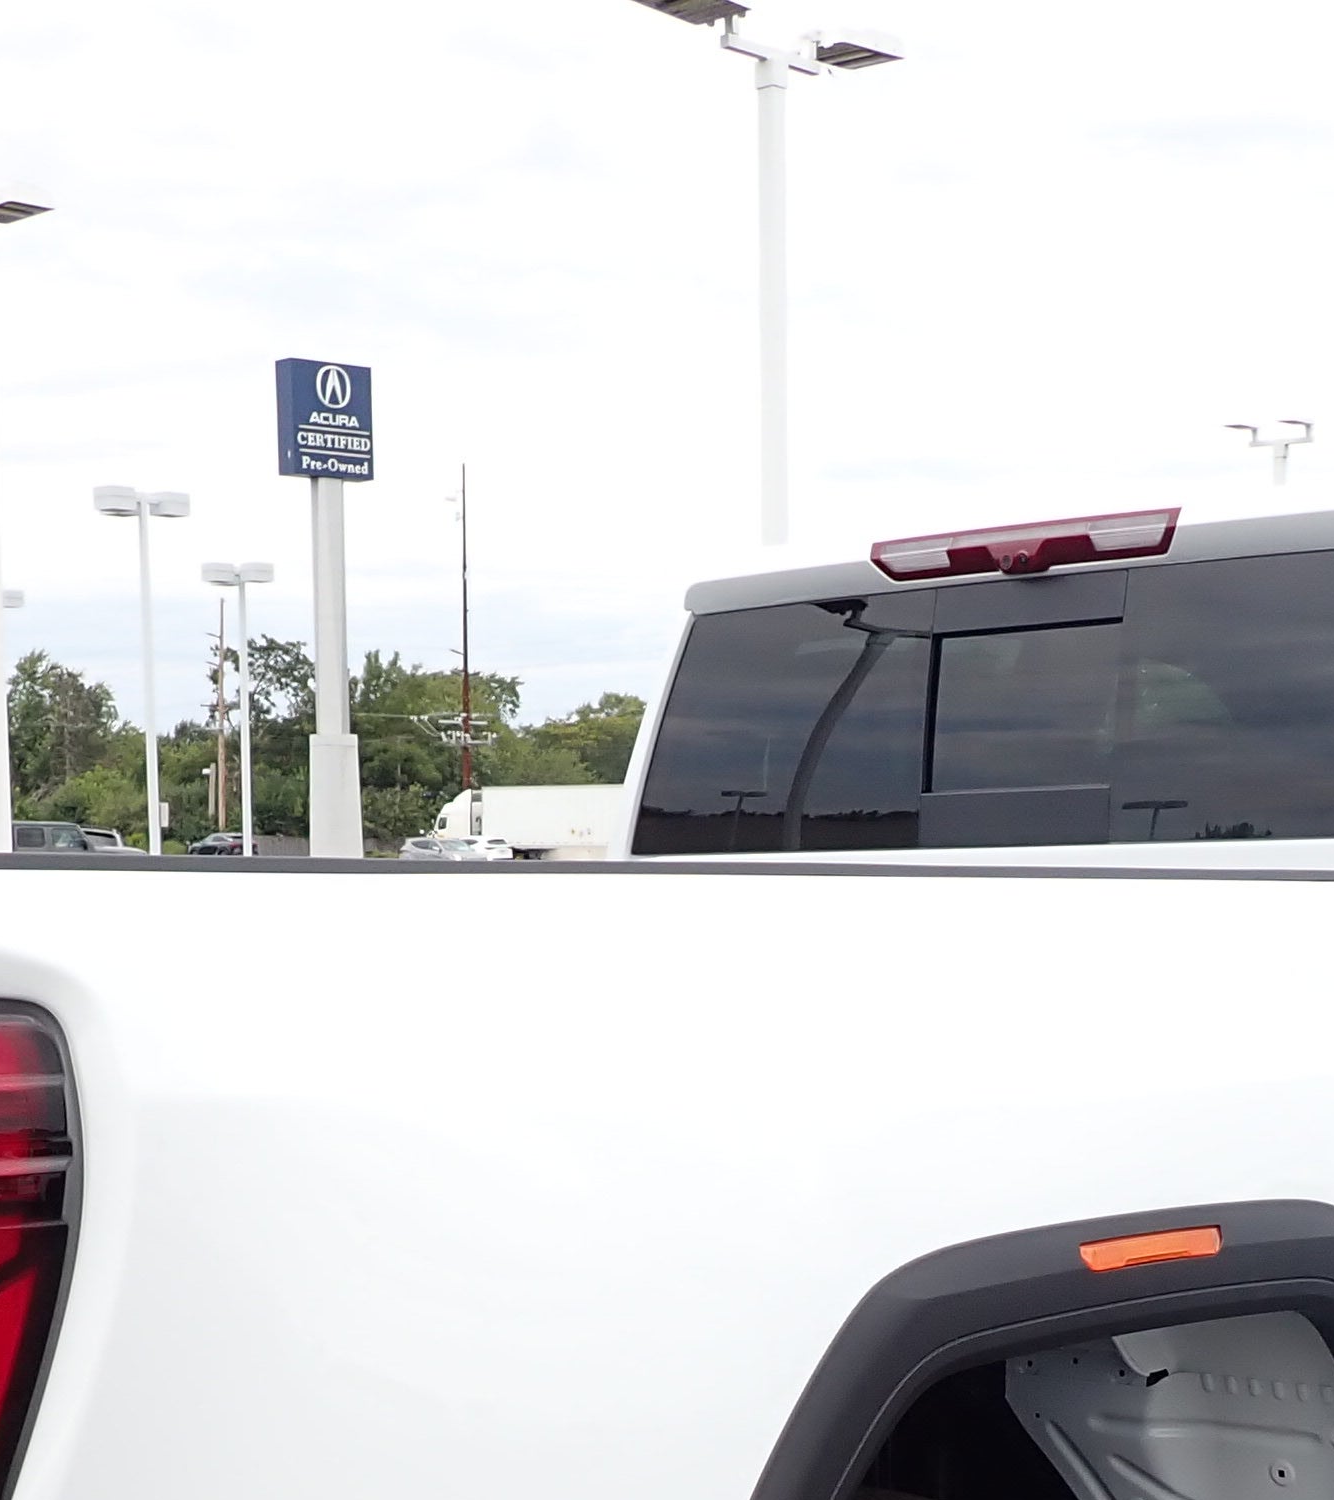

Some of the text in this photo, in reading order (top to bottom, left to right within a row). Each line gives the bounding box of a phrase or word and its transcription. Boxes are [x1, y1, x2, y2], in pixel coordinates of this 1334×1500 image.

[309, 411, 359, 428] ACURA
[297, 431, 370, 451] CERTIFIED
[302, 456, 369, 475] Pre-Owned
